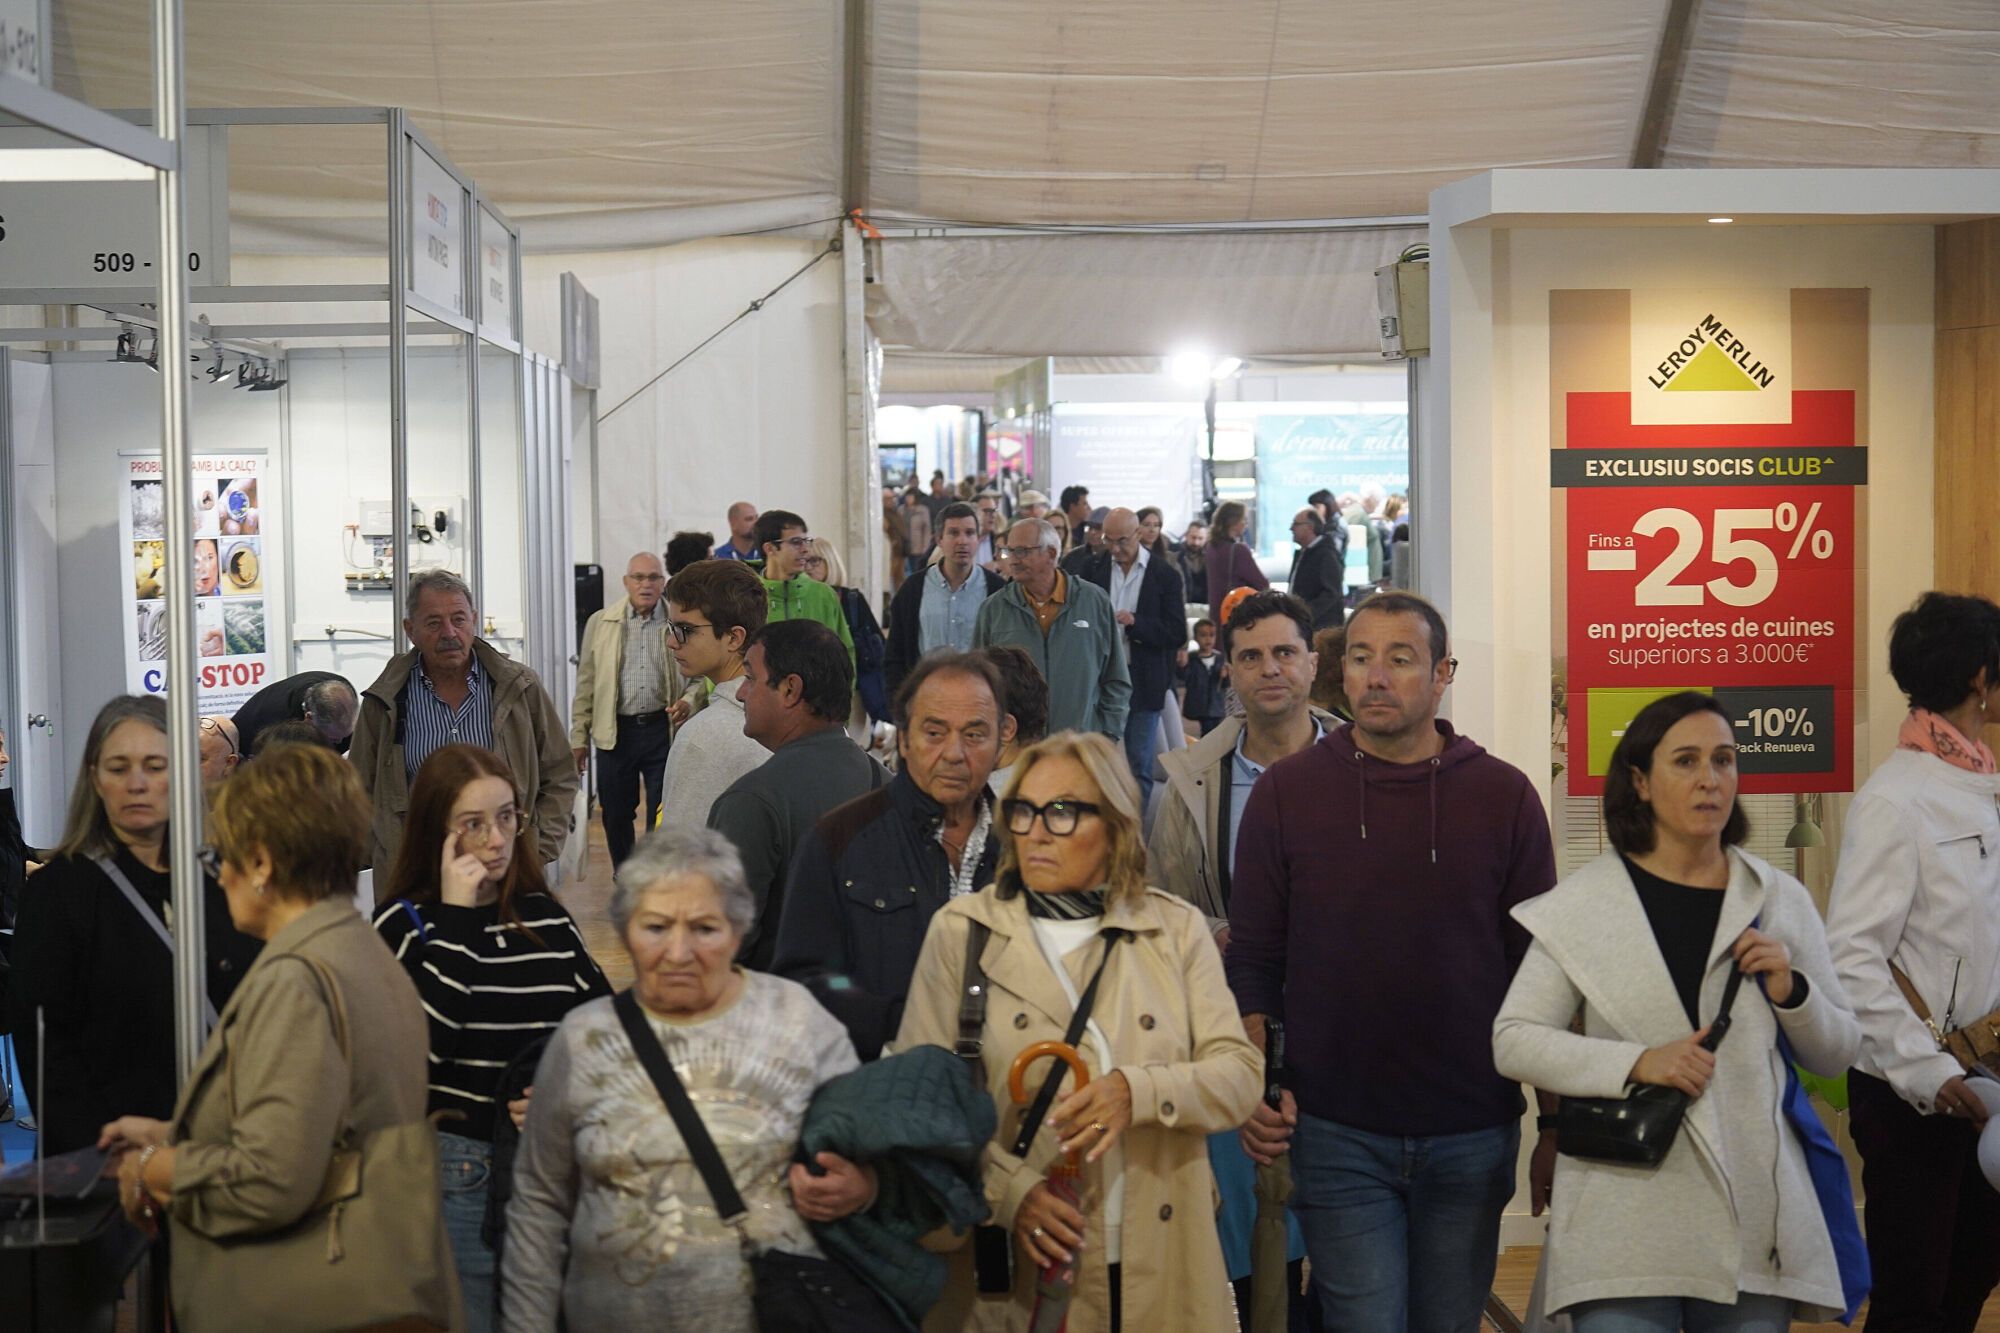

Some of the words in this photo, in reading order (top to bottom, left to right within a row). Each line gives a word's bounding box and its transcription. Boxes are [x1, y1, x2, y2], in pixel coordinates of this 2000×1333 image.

[93, 253, 134, 272] 509
[1648, 327, 1706, 389] LEROY
[1700, 313, 1775, 389] MERLIN
[131, 461, 163, 473] PROBL
[191, 461, 212, 472] AMB
[215, 461, 227, 471] LA
[228, 460, 257, 474] CALÇ?
[1585, 459, 1688, 477] EXCLUSIU
[1692, 458, 1754, 476] SOCIS
[1758, 457, 1821, 476] CLUB
[1589, 534, 1621, 547] Fins
[1624, 537, 1634, 547] a
[1587, 502, 1835, 607] -25%
[1587, 622, 1616, 638] en
[1621, 618, 1727, 643] projectes
[1731, 616, 1759, 637] de
[1763, 616, 1835, 637] cuines
[1608, 643, 1712, 669] superiors
[1716, 648, 1729, 664] a
[144, 662, 265, 693] C-STOP
[1734, 707, 1814, 737] -10%
[1764, 742, 1815, 752] Renueva
